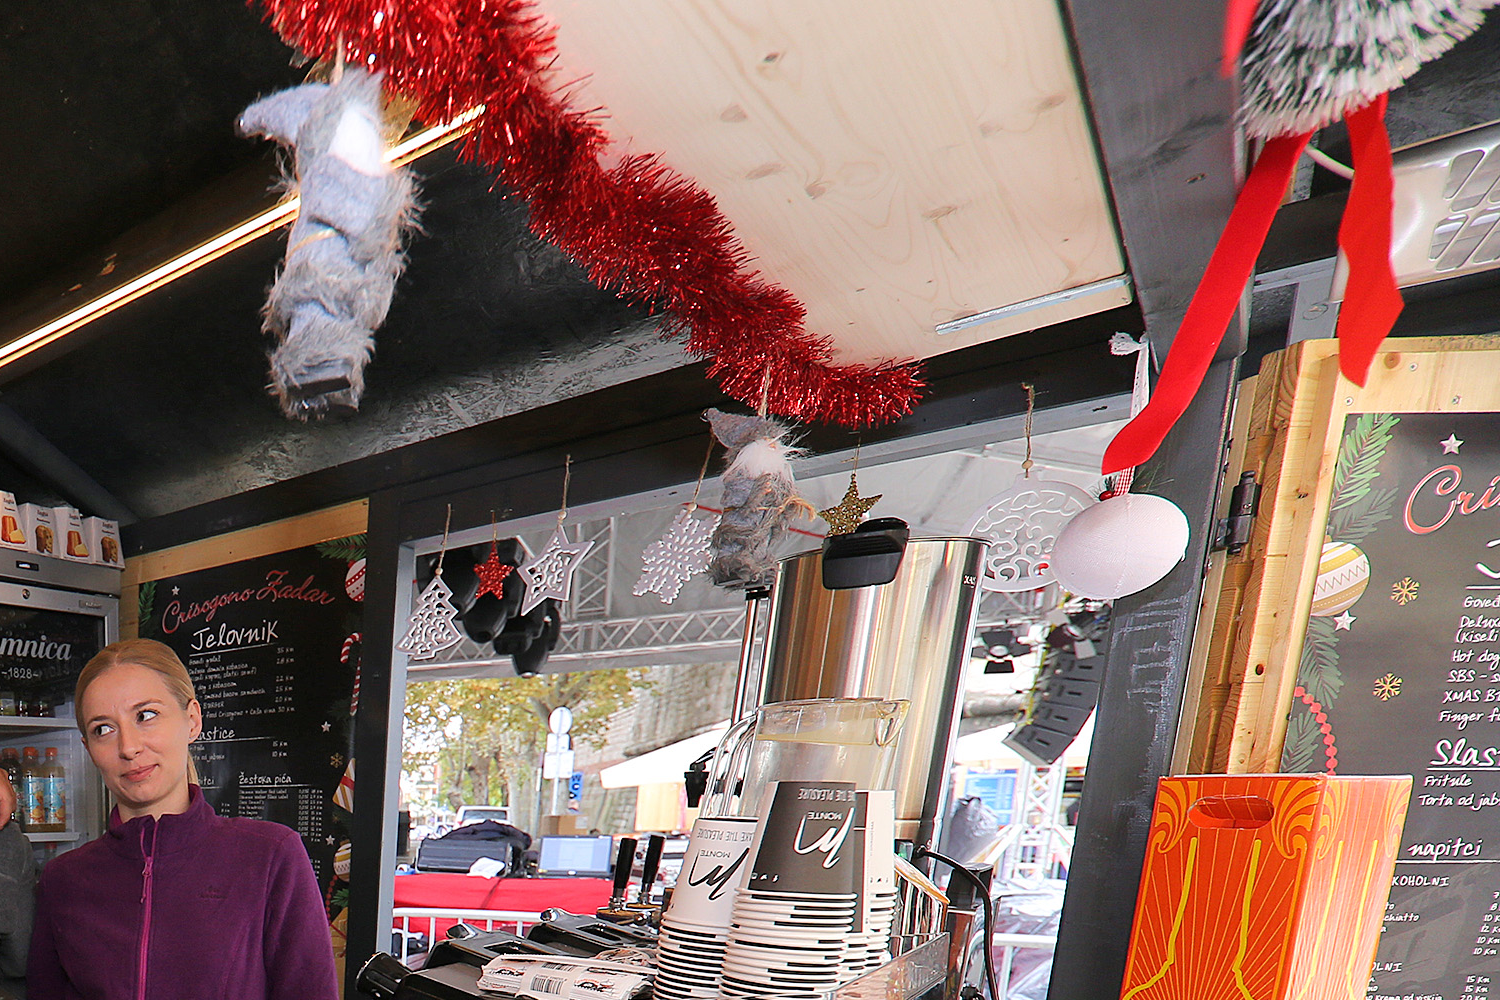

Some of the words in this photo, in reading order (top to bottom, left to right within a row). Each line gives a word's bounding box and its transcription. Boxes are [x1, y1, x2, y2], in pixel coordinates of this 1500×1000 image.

[162, 588, 255, 634] Crisogono
[256, 570, 335, 605] Zadar
[1460, 615, 1500, 629] Delux
[1452, 650, 1474, 663] Hot
[1447, 669, 1476, 683] SBS
[1442, 690, 1481, 704] XMAS
[1438, 711, 1484, 730] Finger
[197, 726, 236, 740] astice
[1424, 774, 1473, 787] Fritule
[1418, 793, 1453, 806] Torta
[1457, 793, 1475, 806] od
[1470, 792, 1500, 811] jab
[807, 811, 842, 821] MONTE
[699, 848, 731, 858] MONTE
[1407, 837, 1483, 862] napitci
[1391, 875, 1450, 887] KOHOLNI
[1383, 913, 1420, 922] chiatto
[1483, 914, 1493, 922] 10
[1476, 936, 1486, 944] 10
[1473, 947, 1482, 955] 10
[1403, 992, 1414, 1000] od
